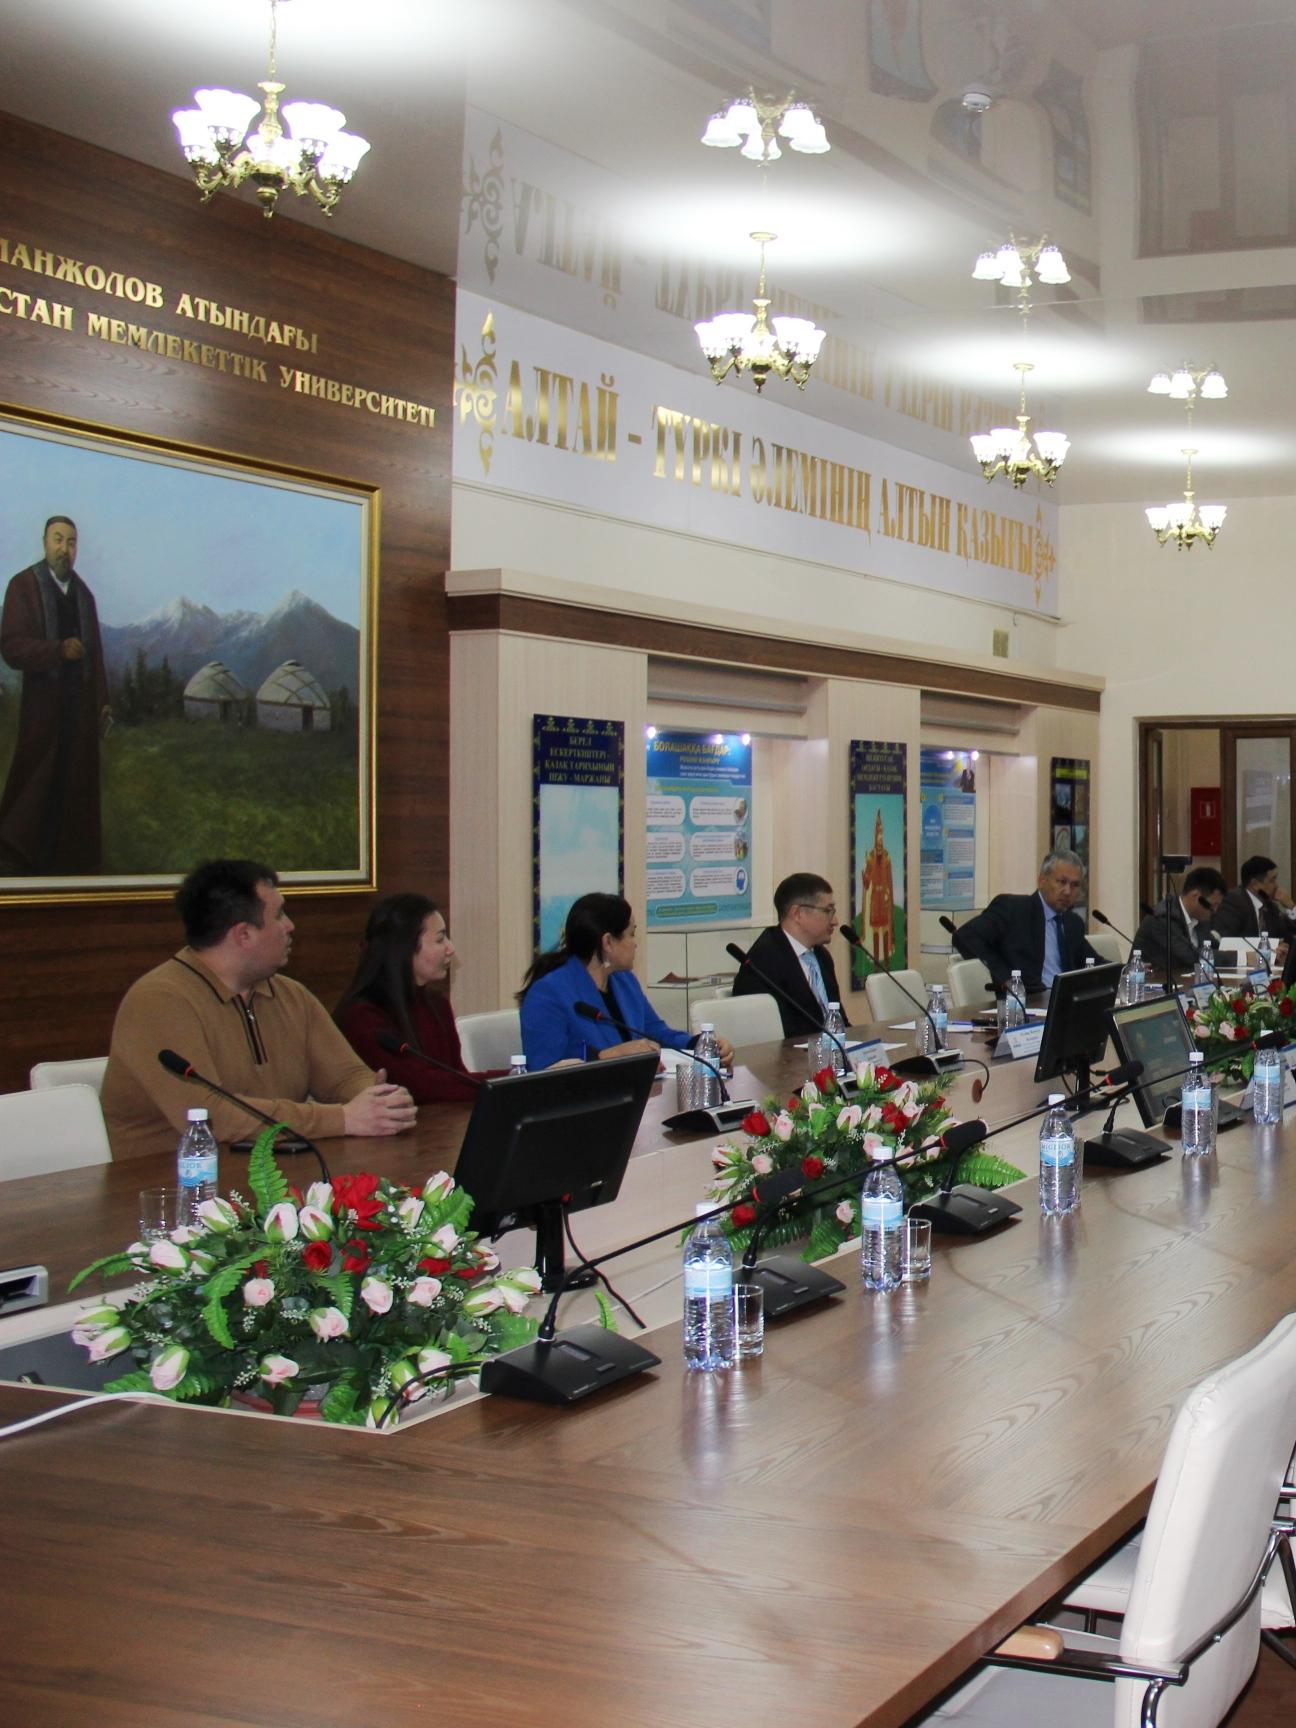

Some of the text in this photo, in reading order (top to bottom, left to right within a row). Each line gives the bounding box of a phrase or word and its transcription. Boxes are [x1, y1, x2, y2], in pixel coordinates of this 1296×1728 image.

[87, 312, 268, 383] МЕМЛЕКЕТТІК
[279, 365, 435, 428] УНИВЕРСИТЕТІ
[175, 293, 318, 354] АТЫНДАҒЫ
[501, 360, 619, 464] АЛТАЙ
[751, 435, 871, 548] ӘЛЕМІНІҢ
[878, 477, 951, 553] АЛТЫН
